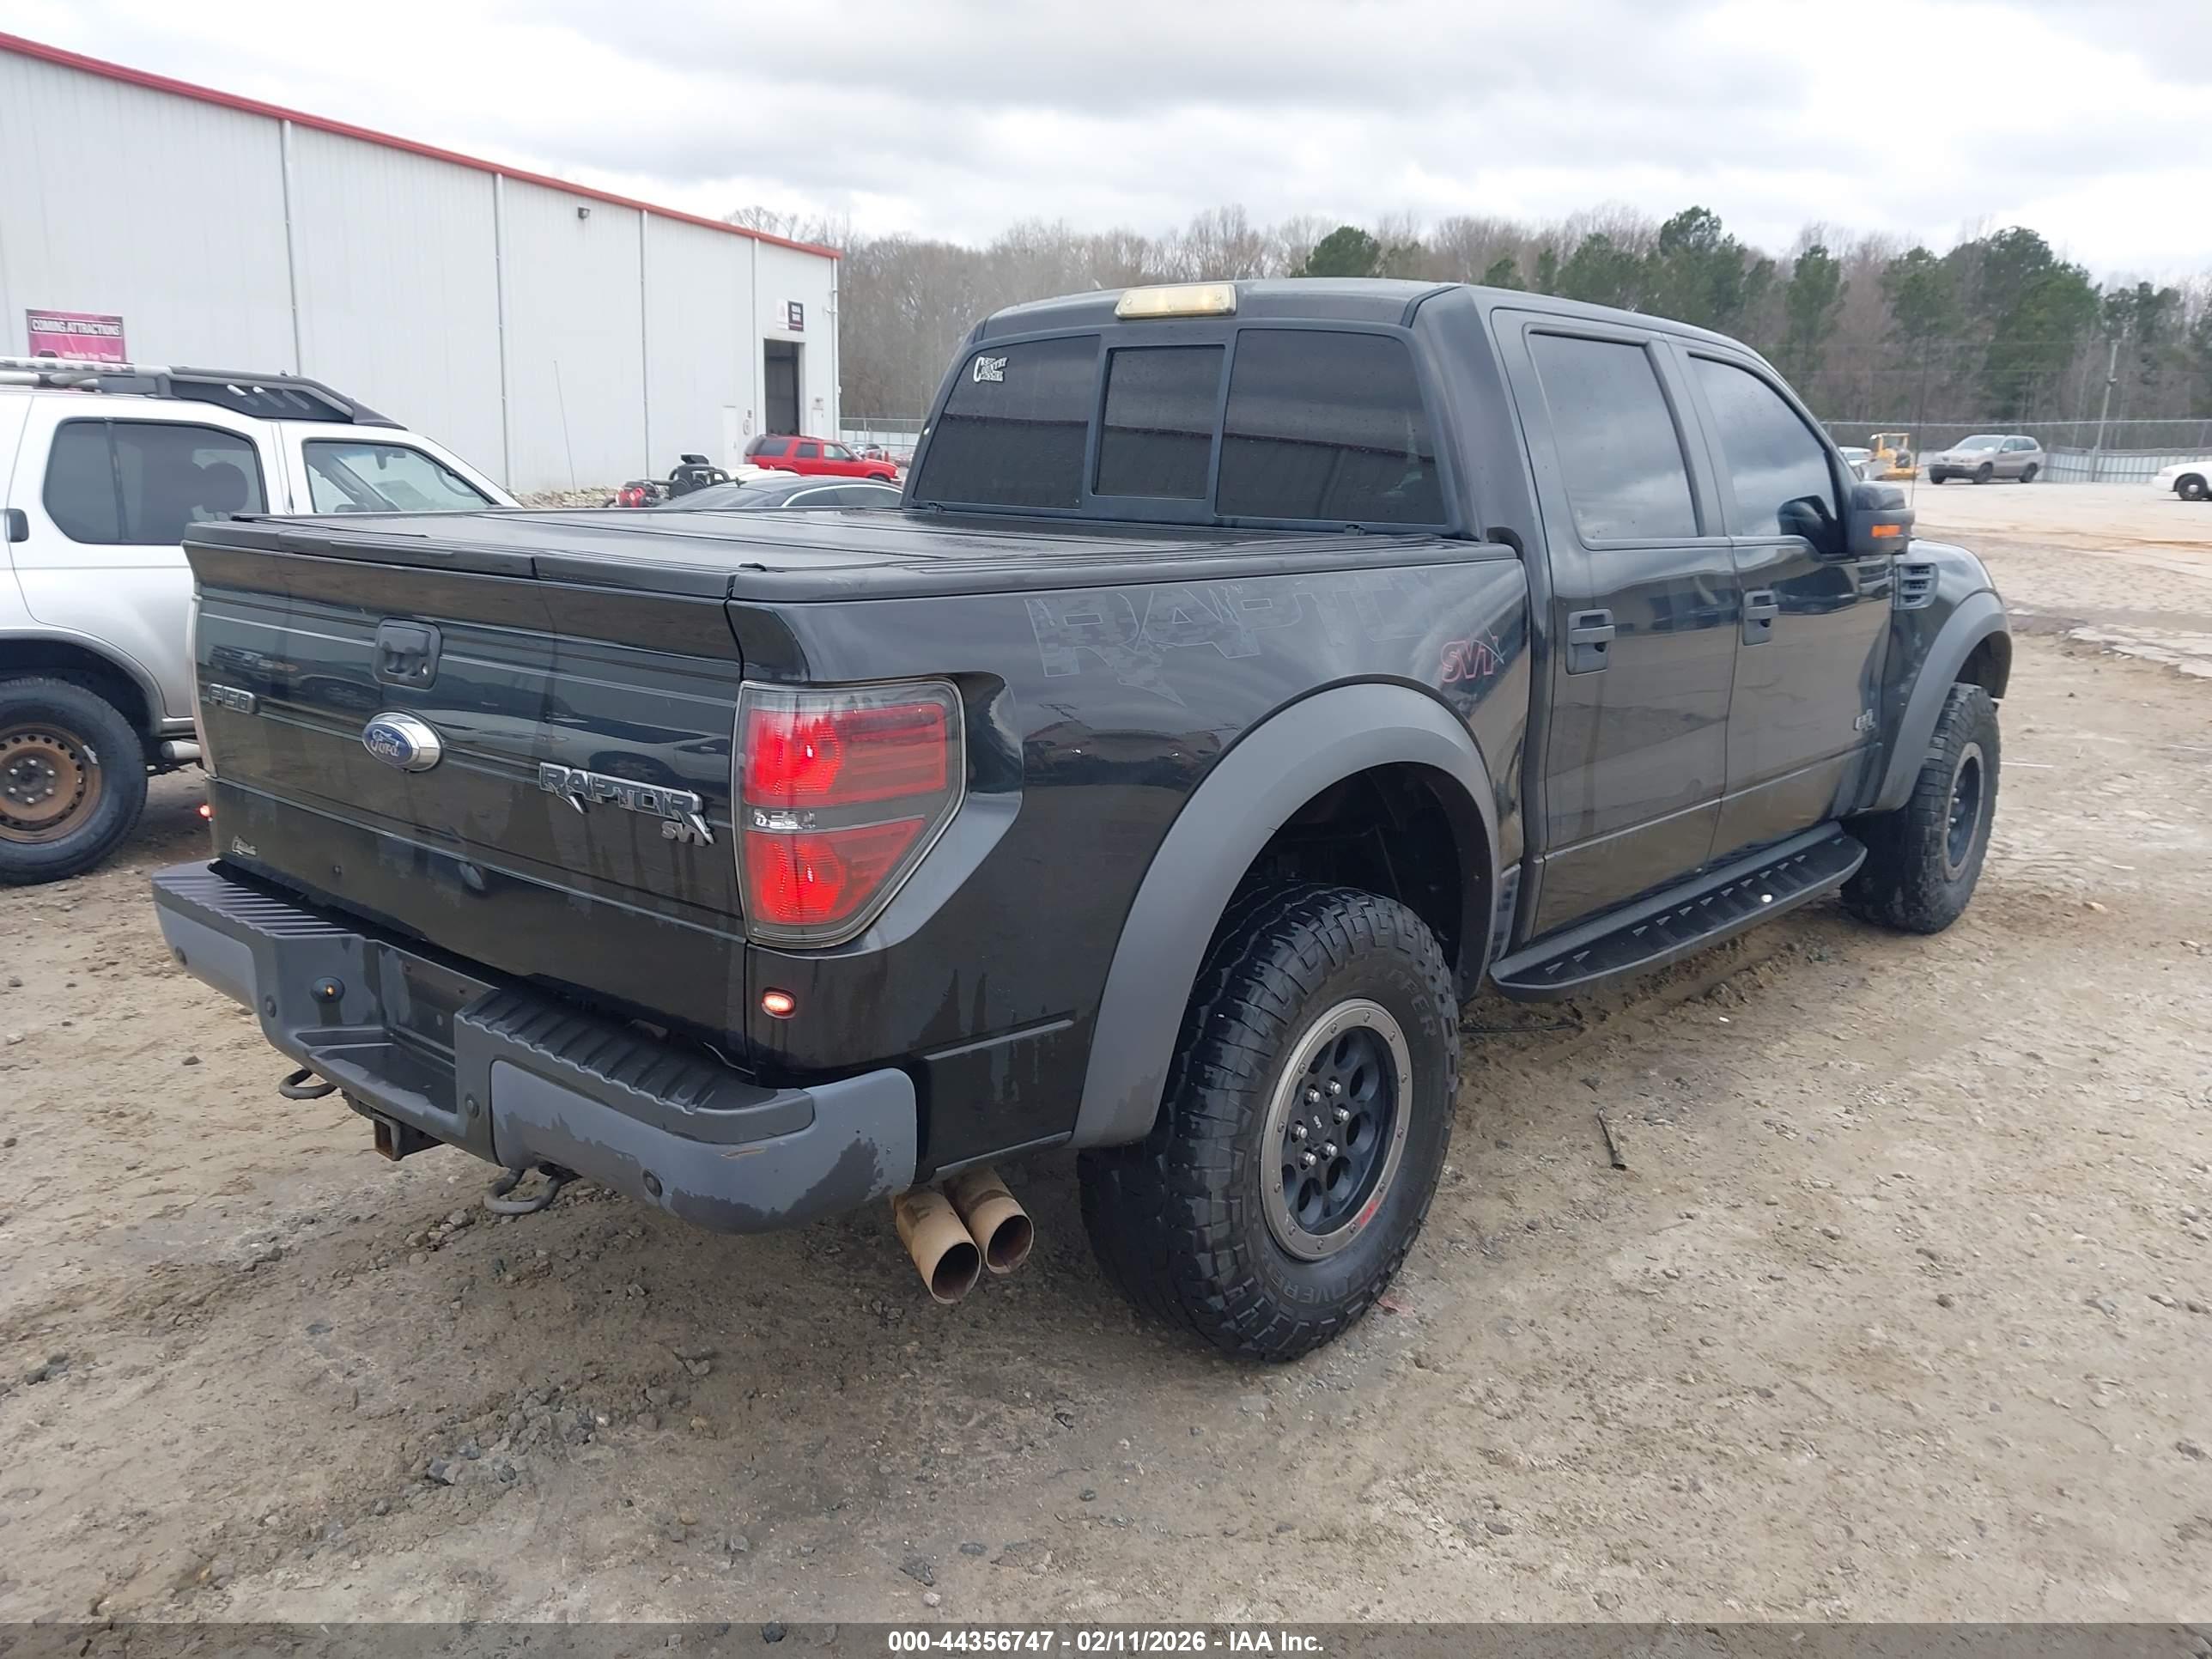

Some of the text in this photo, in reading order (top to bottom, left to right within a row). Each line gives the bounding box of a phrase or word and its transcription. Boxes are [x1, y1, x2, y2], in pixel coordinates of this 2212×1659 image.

[32, 319, 120, 336] COMING ATTRACTIONS
[539, 762, 715, 845] RAPTOR
